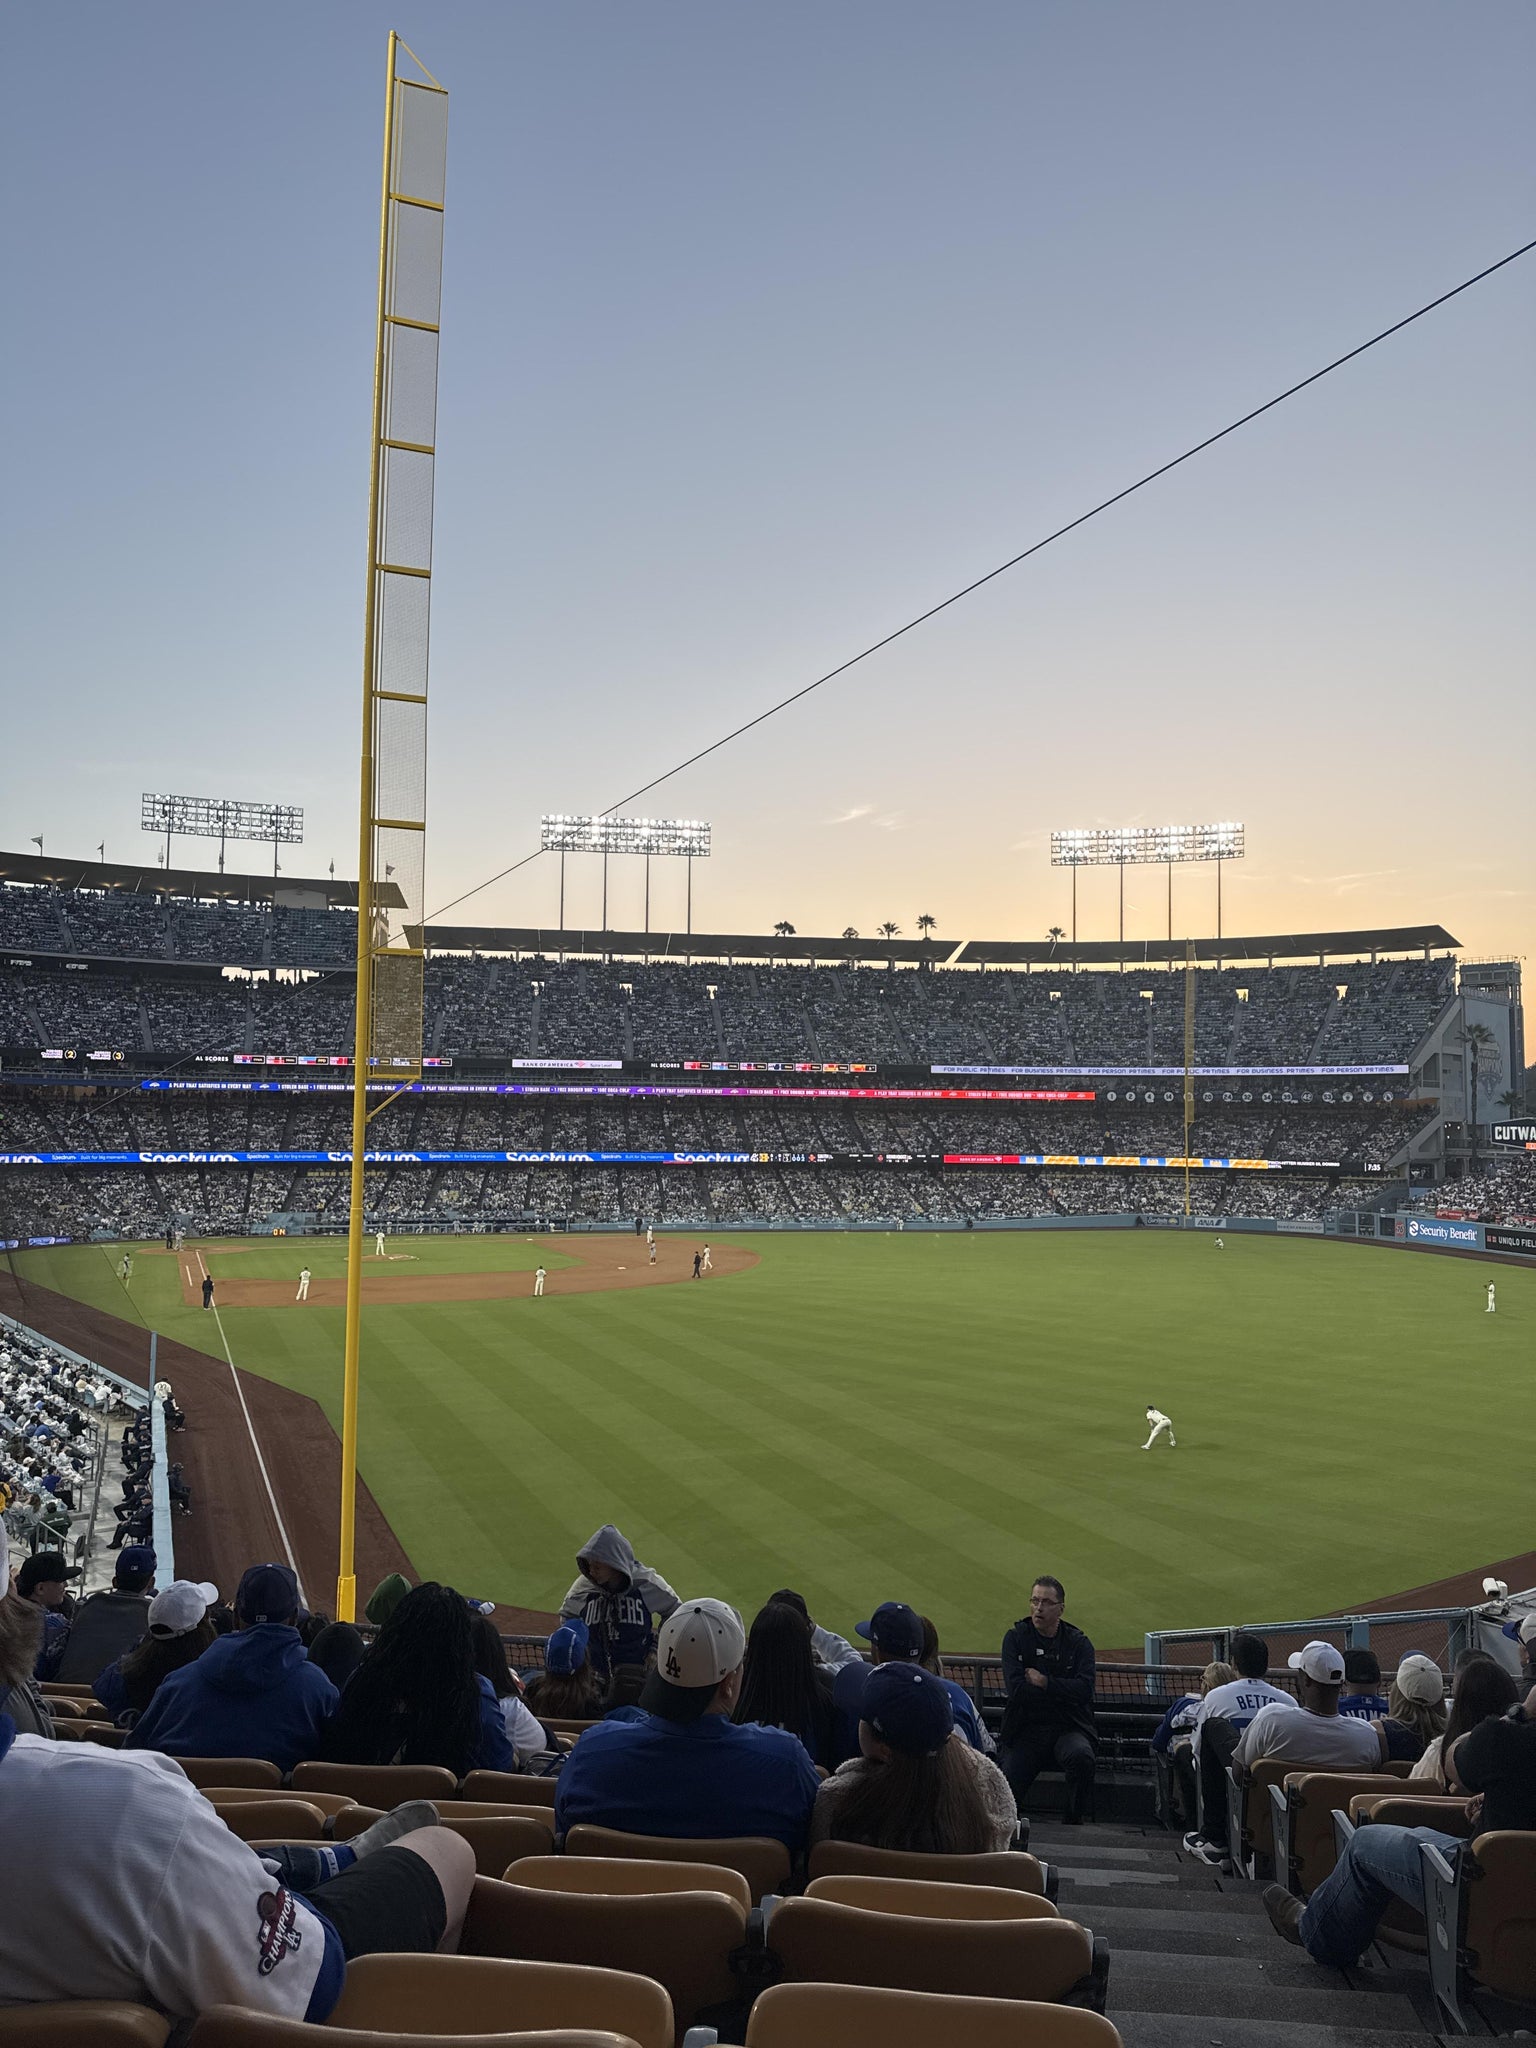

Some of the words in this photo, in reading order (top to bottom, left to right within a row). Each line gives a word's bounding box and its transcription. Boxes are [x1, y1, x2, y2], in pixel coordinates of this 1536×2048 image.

[139, 1152, 236, 1163] Spectrum
[328, 1152, 418, 1162] Spctrum
[506, 1152, 591, 1162] Spectrum
[1368, 1163, 1381, 1171] 7:35
[1197, 1219, 1214, 1227] ANA
[1420, 1223, 1448, 1240] Security
[1498, 1236, 1520, 1247] UNIQLO
[1521, 1238, 1536, 1248] FIEL
[666, 1646, 681, 1679] LA
